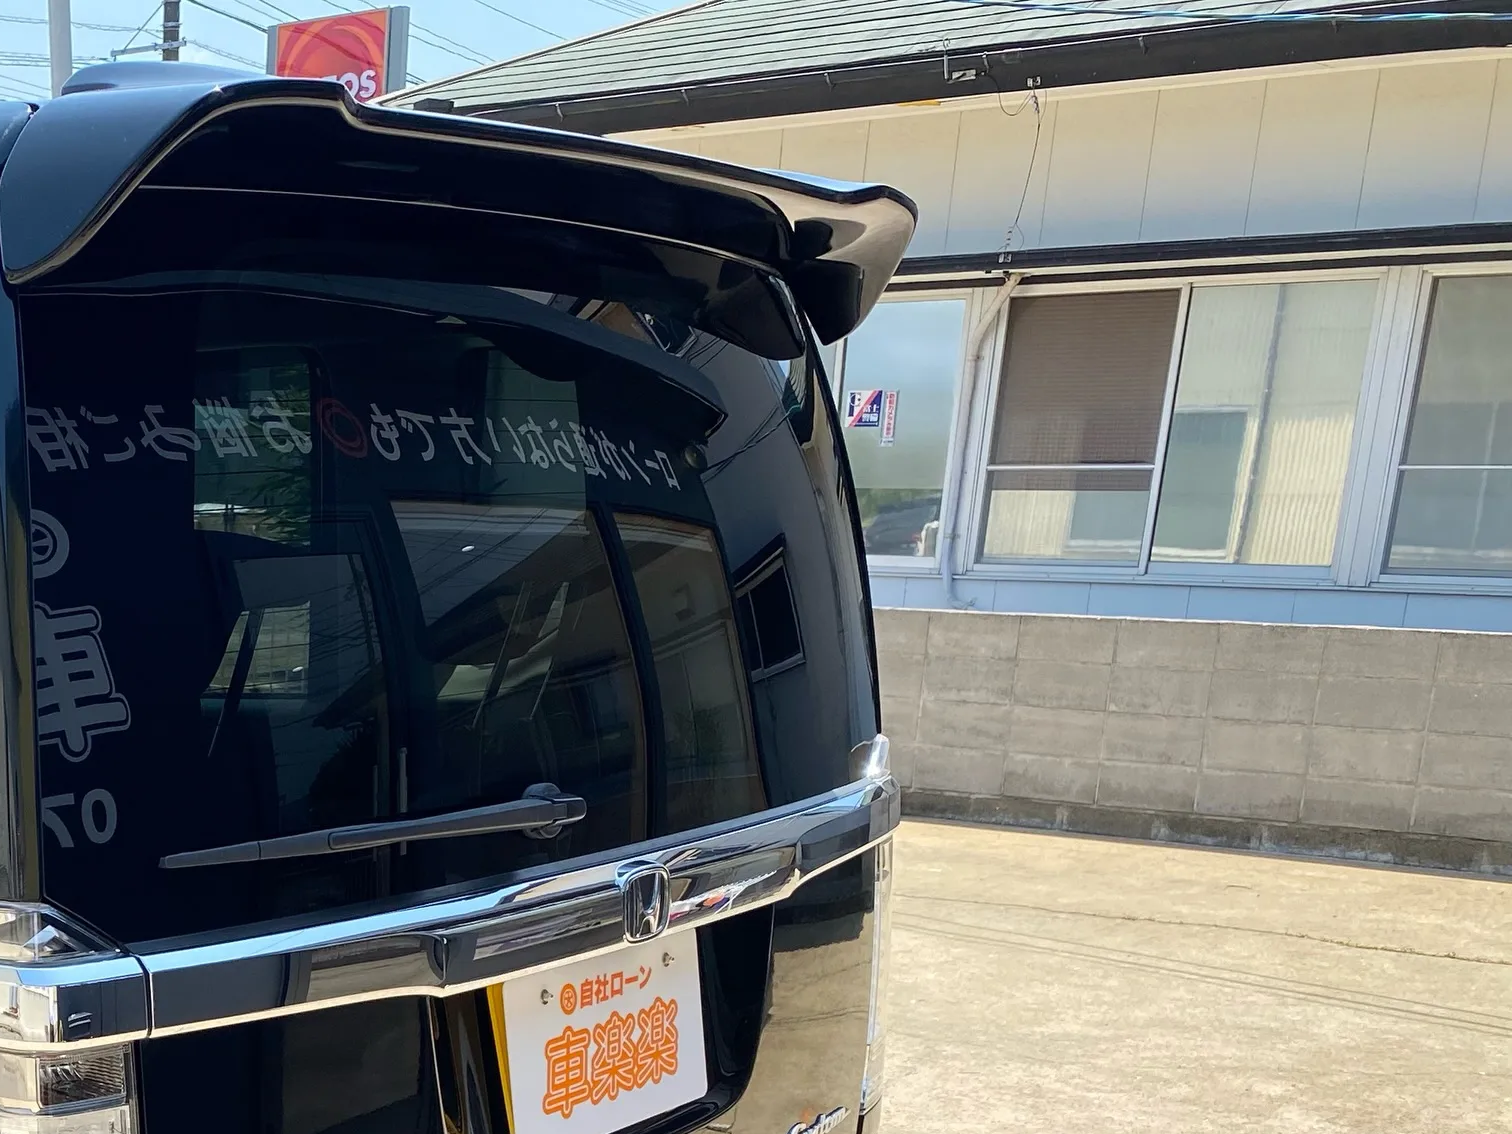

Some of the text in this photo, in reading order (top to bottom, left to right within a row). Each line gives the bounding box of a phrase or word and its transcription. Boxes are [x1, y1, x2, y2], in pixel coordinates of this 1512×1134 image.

[580, 966, 652, 1009] 自社ローン
[542, 996, 678, 1120] 車楽楽
